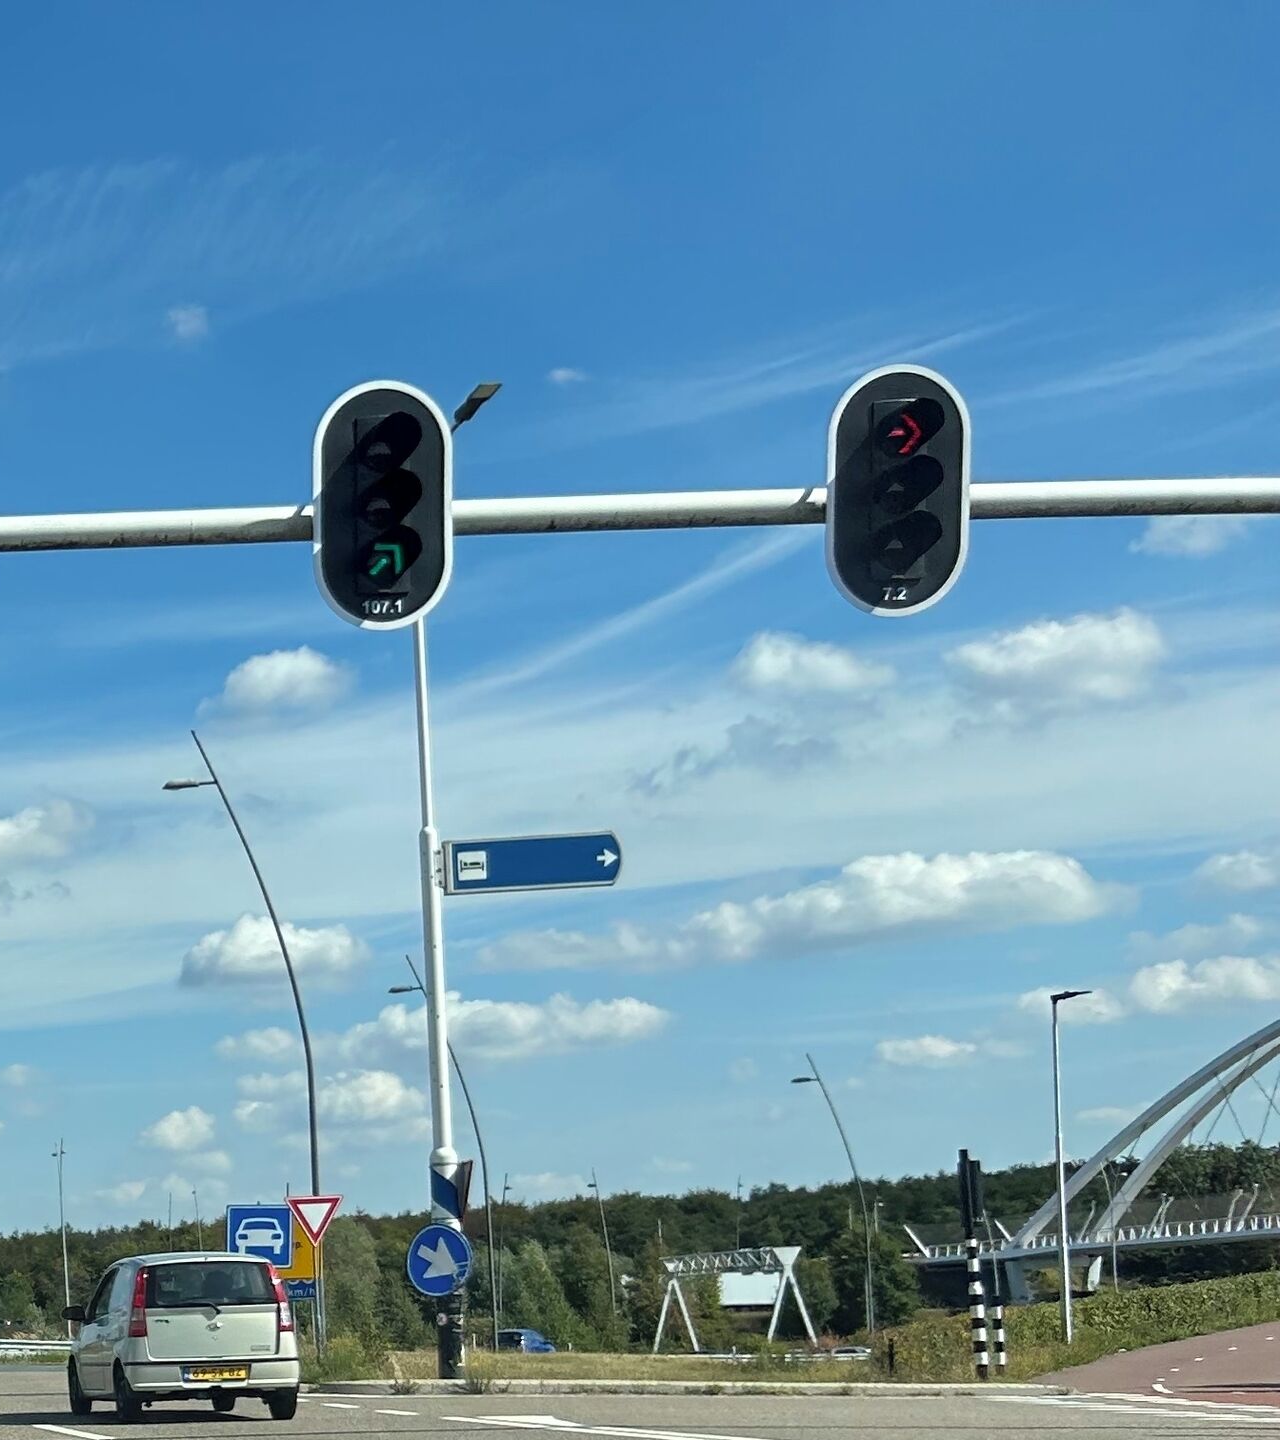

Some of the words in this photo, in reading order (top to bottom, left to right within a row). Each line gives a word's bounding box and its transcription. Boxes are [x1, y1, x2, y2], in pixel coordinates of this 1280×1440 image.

[882, 587, 907, 601] 7.2
[362, 599, 402, 614] 107.1
[288, 1287, 316, 1297] km/h
